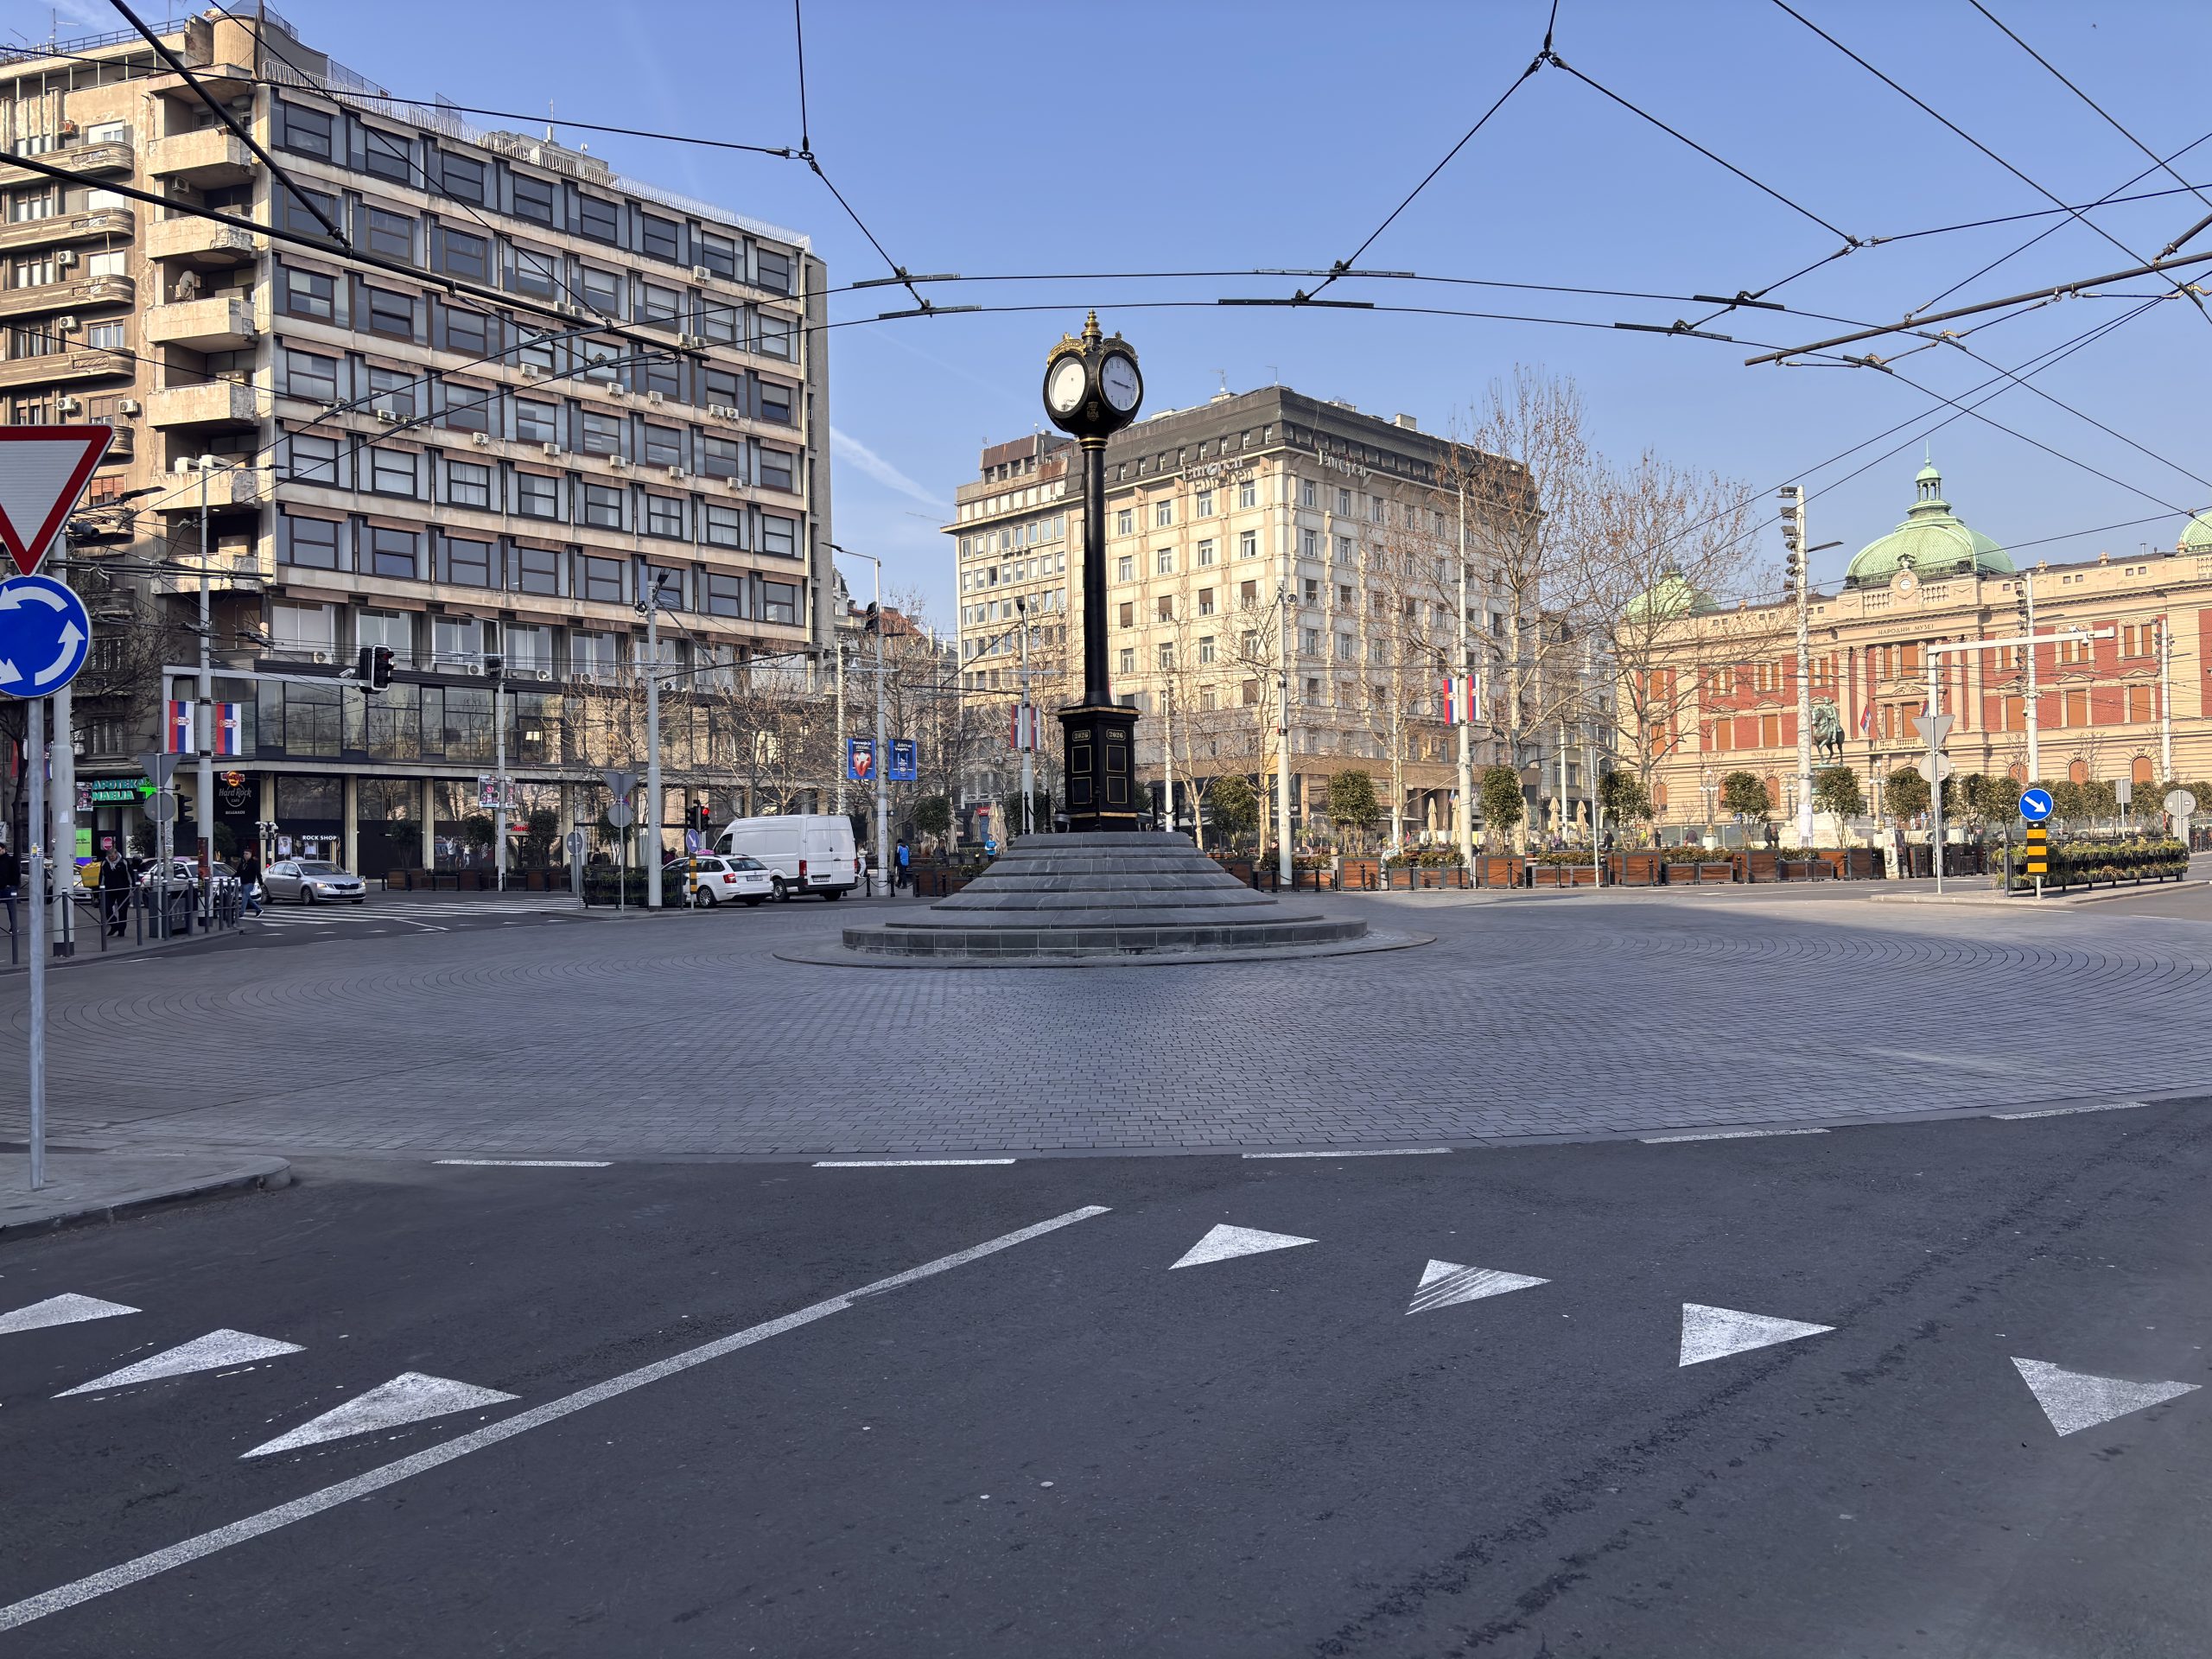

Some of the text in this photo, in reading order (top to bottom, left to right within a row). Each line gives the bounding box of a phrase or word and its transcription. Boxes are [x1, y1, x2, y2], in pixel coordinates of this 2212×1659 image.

[1878, 626, 1910, 635] НАРОДНИ
[219, 787, 252, 798] Hard Rock
